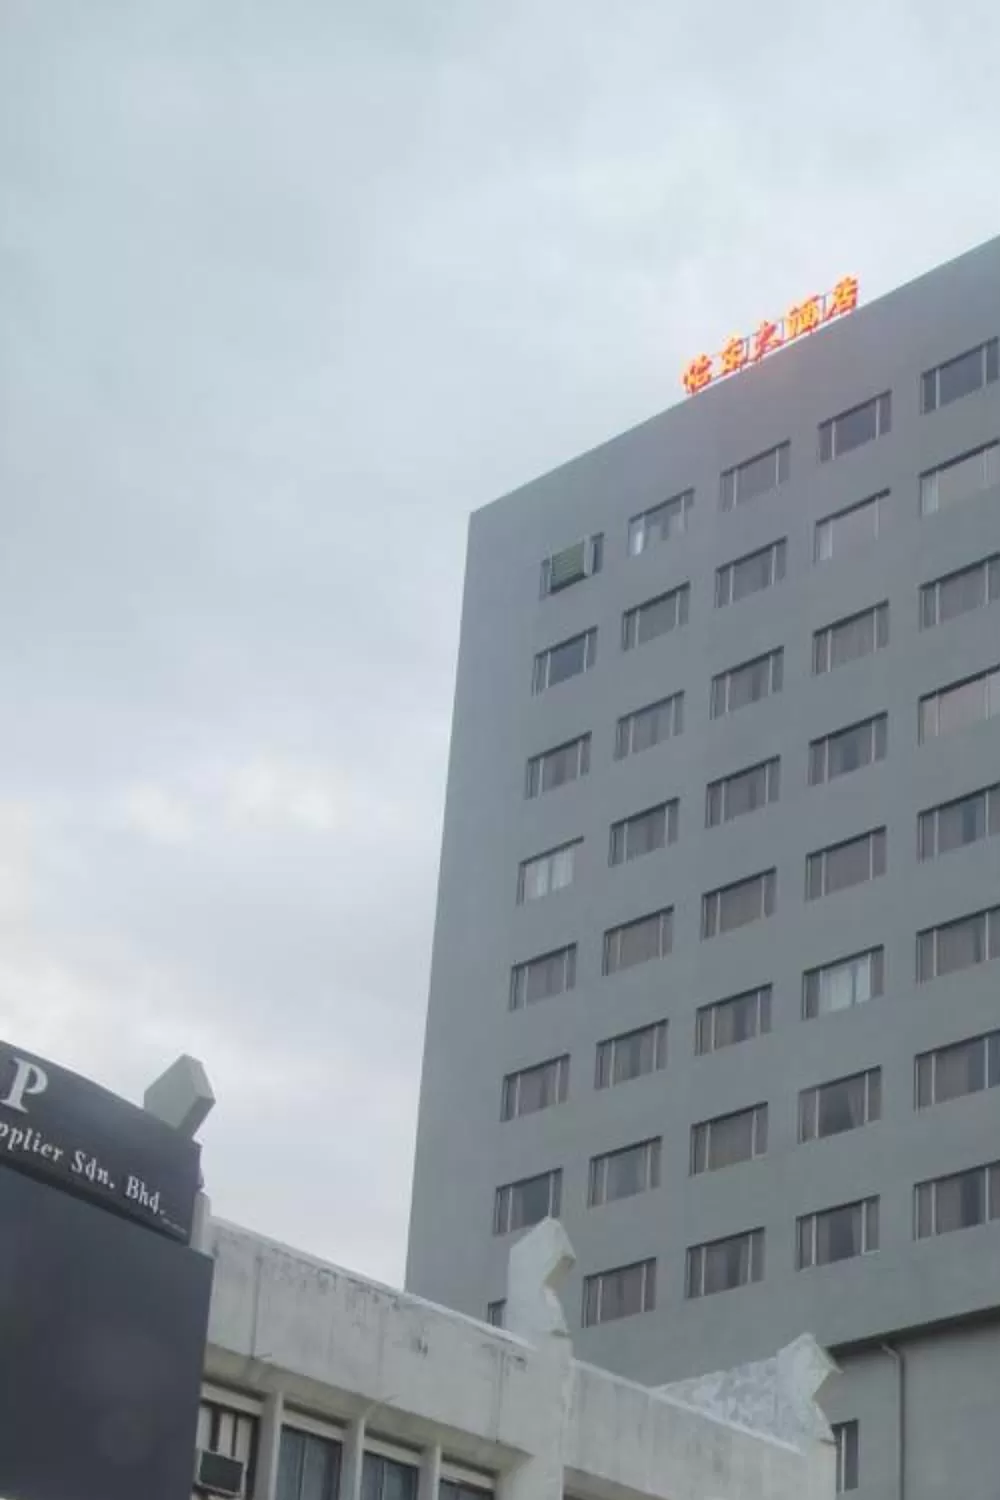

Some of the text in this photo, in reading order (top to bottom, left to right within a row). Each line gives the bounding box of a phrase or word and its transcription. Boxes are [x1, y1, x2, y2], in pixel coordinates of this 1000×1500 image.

[1, 1056, 48, 1113] P
[71, 1150, 116, 1189] Sdn.
[126, 1175, 165, 1216] Bhd.
